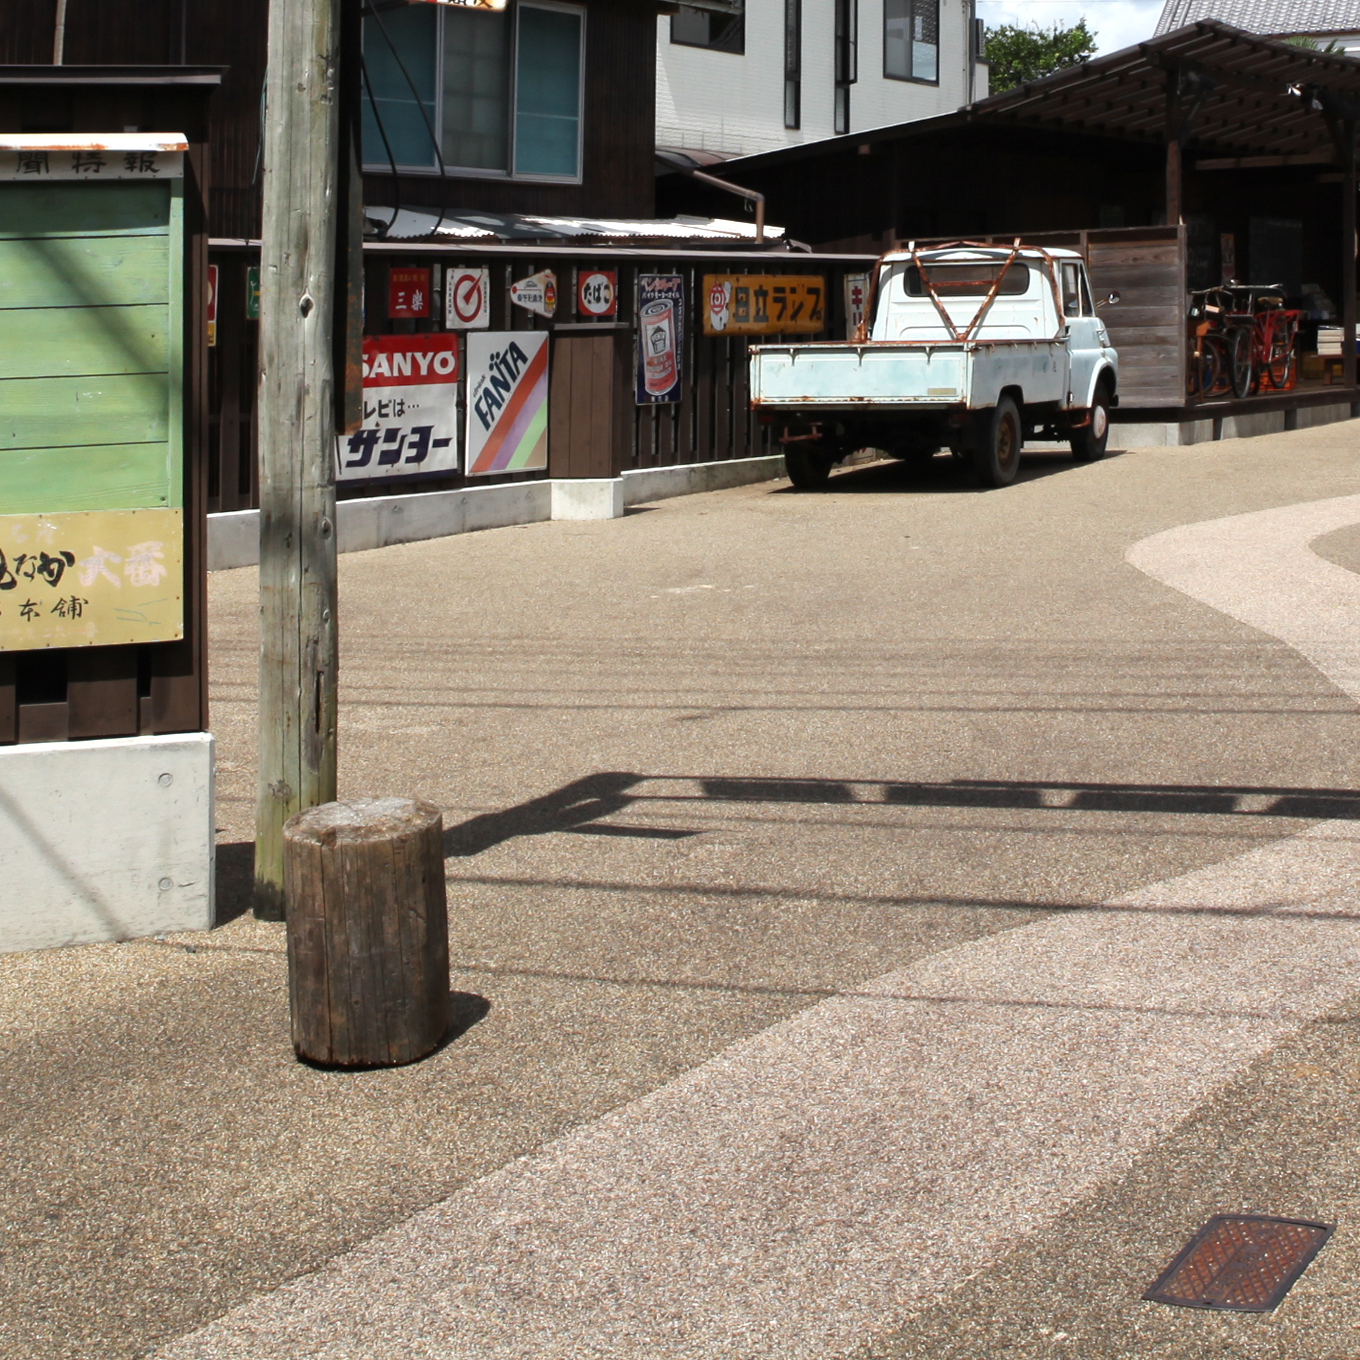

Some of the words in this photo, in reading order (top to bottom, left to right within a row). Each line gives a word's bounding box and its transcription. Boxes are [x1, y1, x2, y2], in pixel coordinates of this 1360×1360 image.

[583, 281, 610, 305] たばこ
[734, 283, 823, 324] 日立ランプ
[474, 341, 529, 432] FANTA
[344, 425, 453, 469] サンヨー
